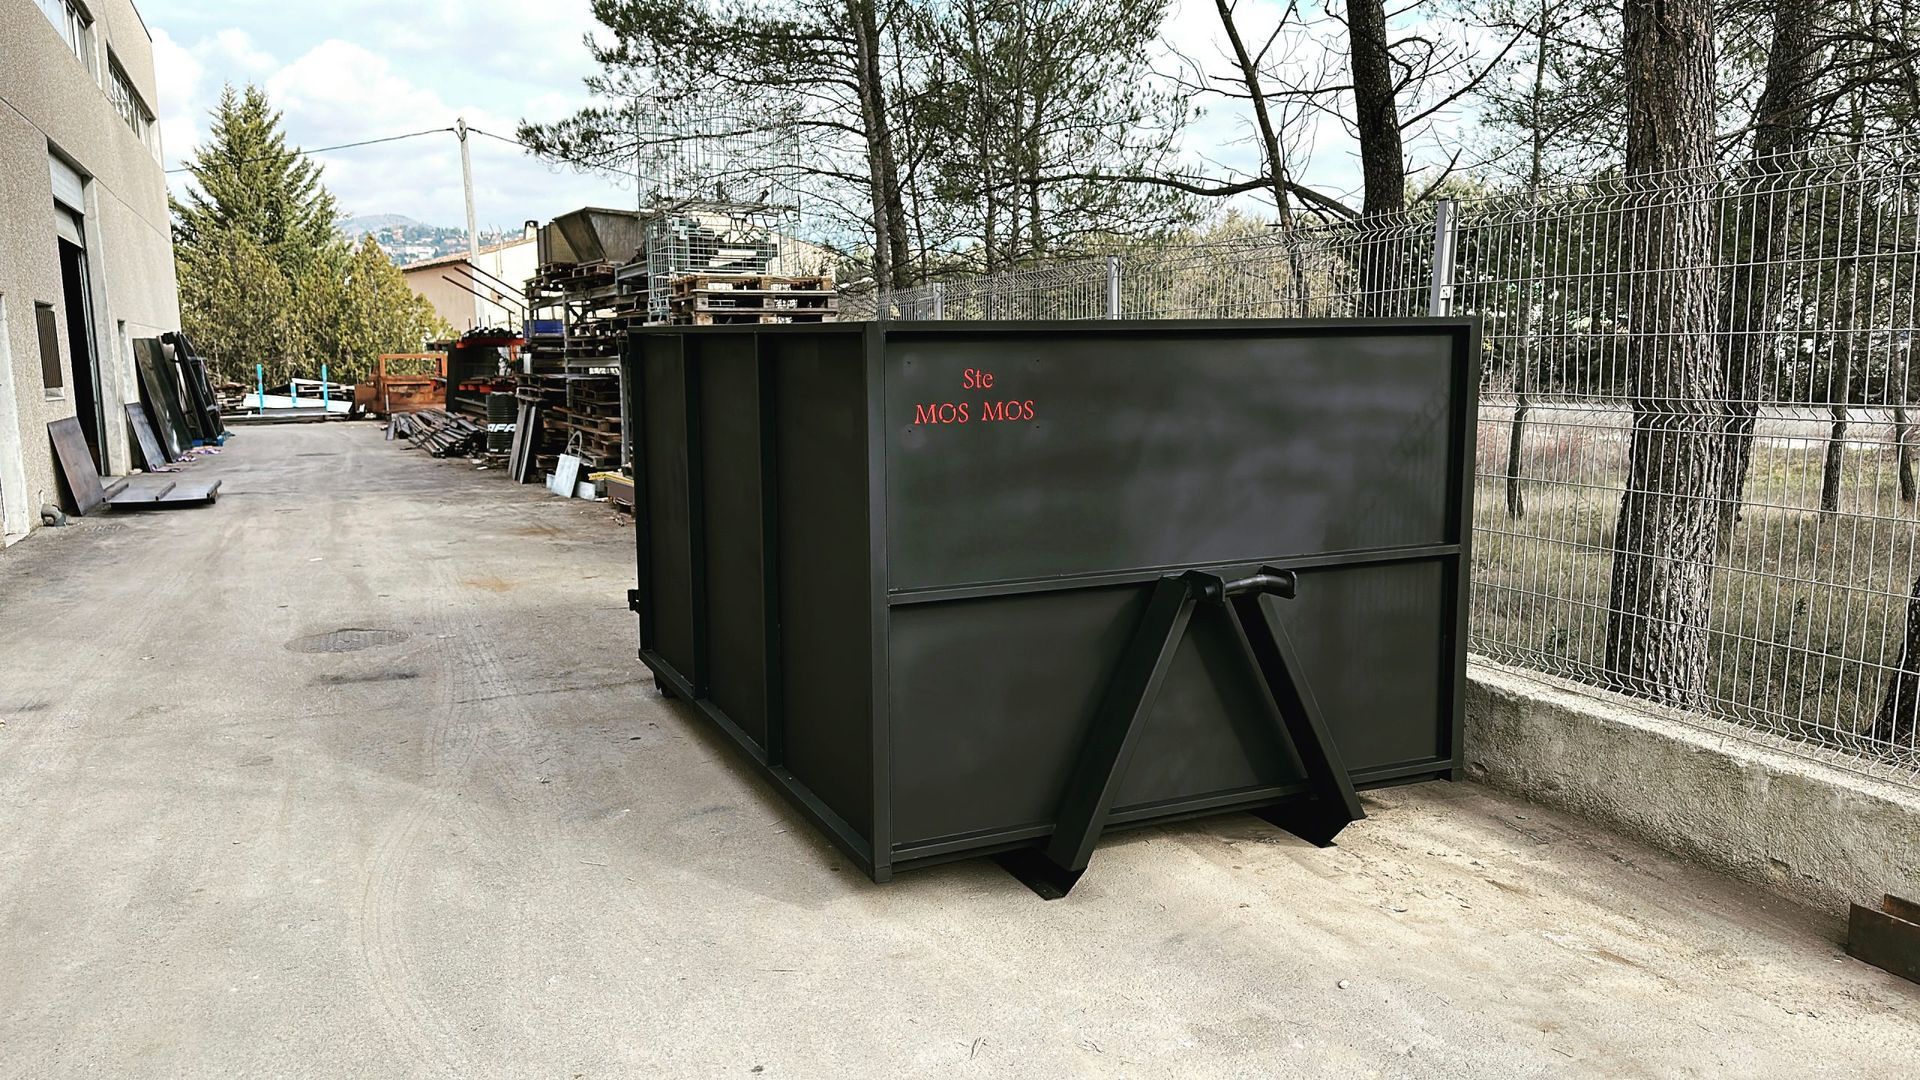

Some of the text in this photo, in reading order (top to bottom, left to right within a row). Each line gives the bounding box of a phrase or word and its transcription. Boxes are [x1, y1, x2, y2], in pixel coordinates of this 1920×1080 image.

[963, 368, 994, 389] Ste
[914, 400, 1035, 425] MOS MOS
